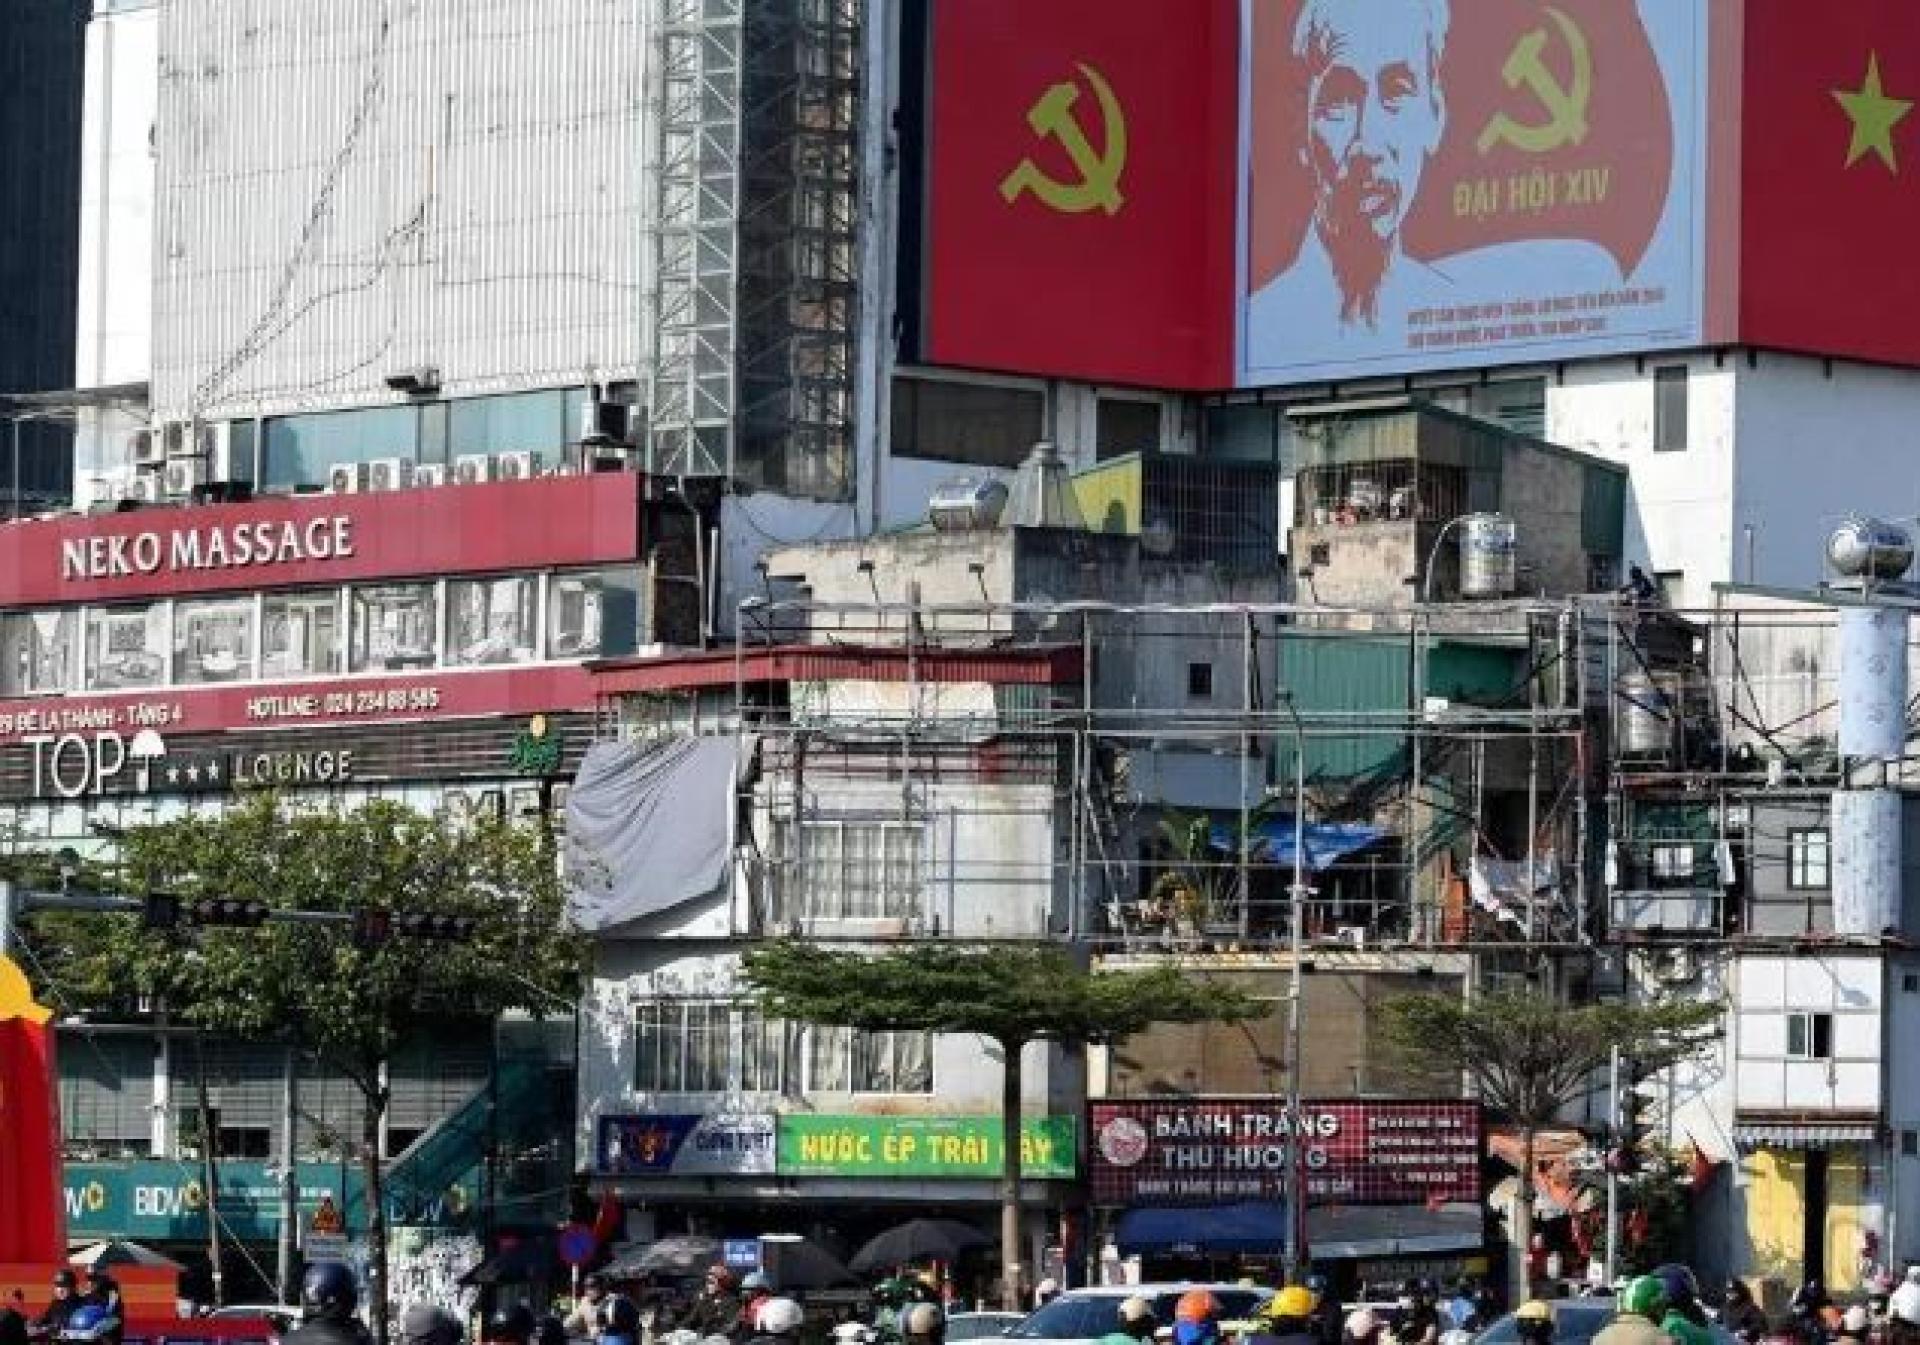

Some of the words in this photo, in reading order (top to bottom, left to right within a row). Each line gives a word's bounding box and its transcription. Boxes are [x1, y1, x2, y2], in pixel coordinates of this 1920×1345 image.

[1454, 178, 1497, 222] ĐẠI
[1509, 166, 1554, 214] HỘI
[1566, 168, 1609, 204] XIV
[63, 531, 162, 578] NEKO
[170, 514, 353, 571] MASSAGE
[21, 732, 125, 797] TOP
[800, 1126, 873, 1163] NƯỚC
[883, 1126, 916, 1164] ÉP
[926, 1129, 989, 1165] TRÁI
[1163, 1145, 1212, 1169] THU
